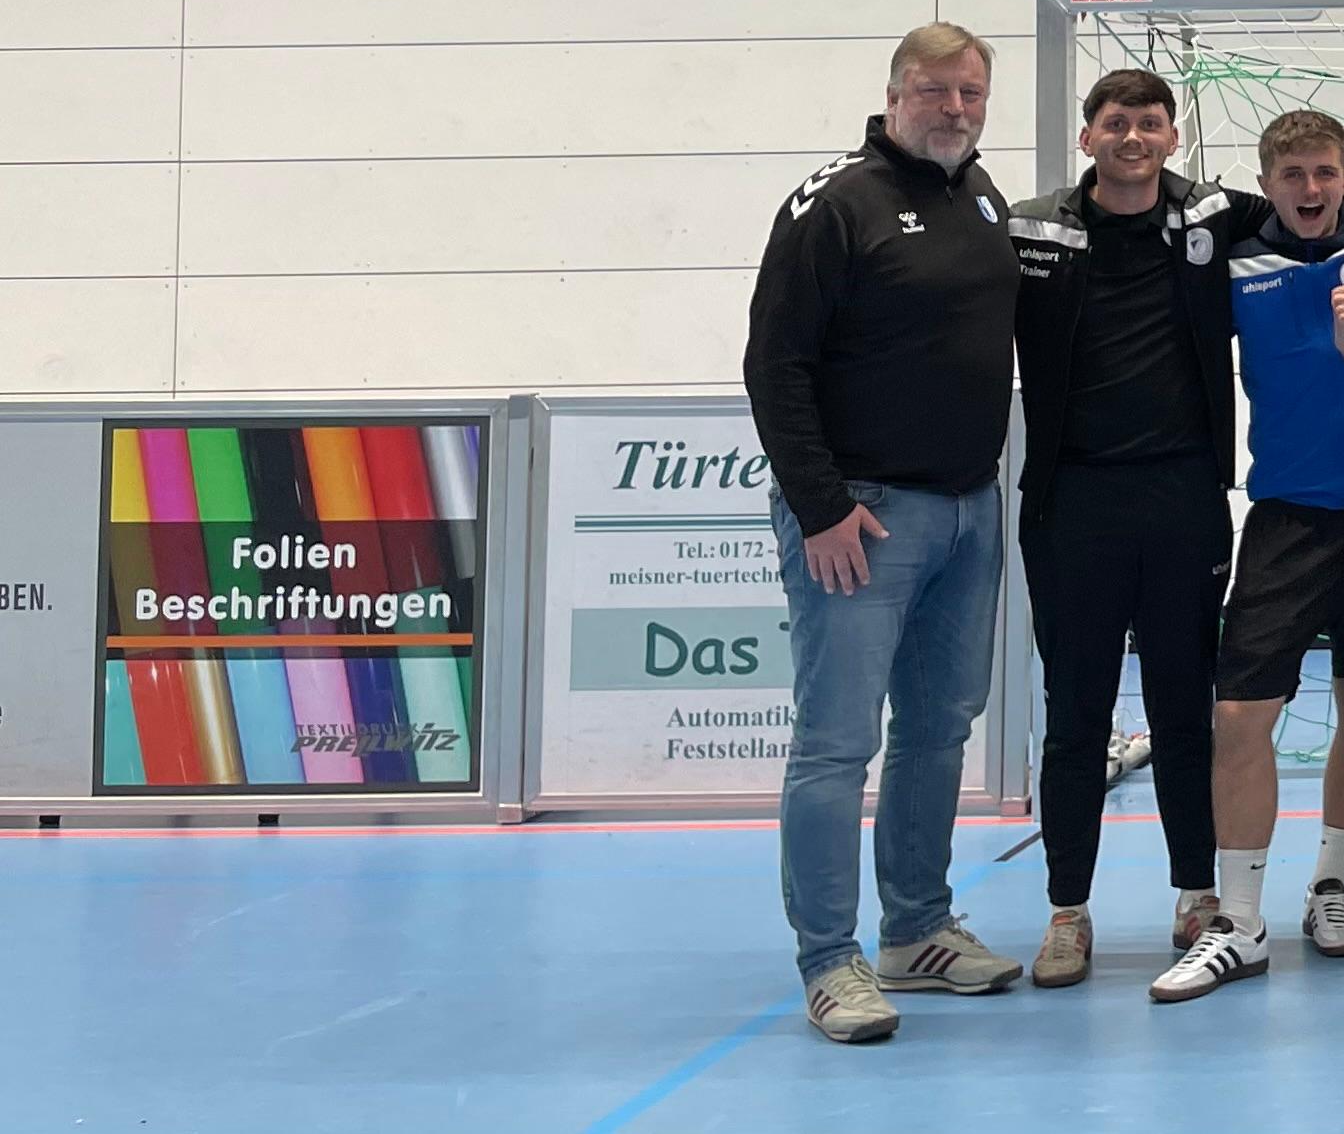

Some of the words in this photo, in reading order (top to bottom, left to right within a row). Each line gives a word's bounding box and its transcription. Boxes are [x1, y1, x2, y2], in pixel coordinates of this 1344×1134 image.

[612, 440, 773, 491] Türte
[232, 535, 357, 570] Folien
[135, 585, 453, 628] Beschriftungen
[644, 621, 760, 678] Das
